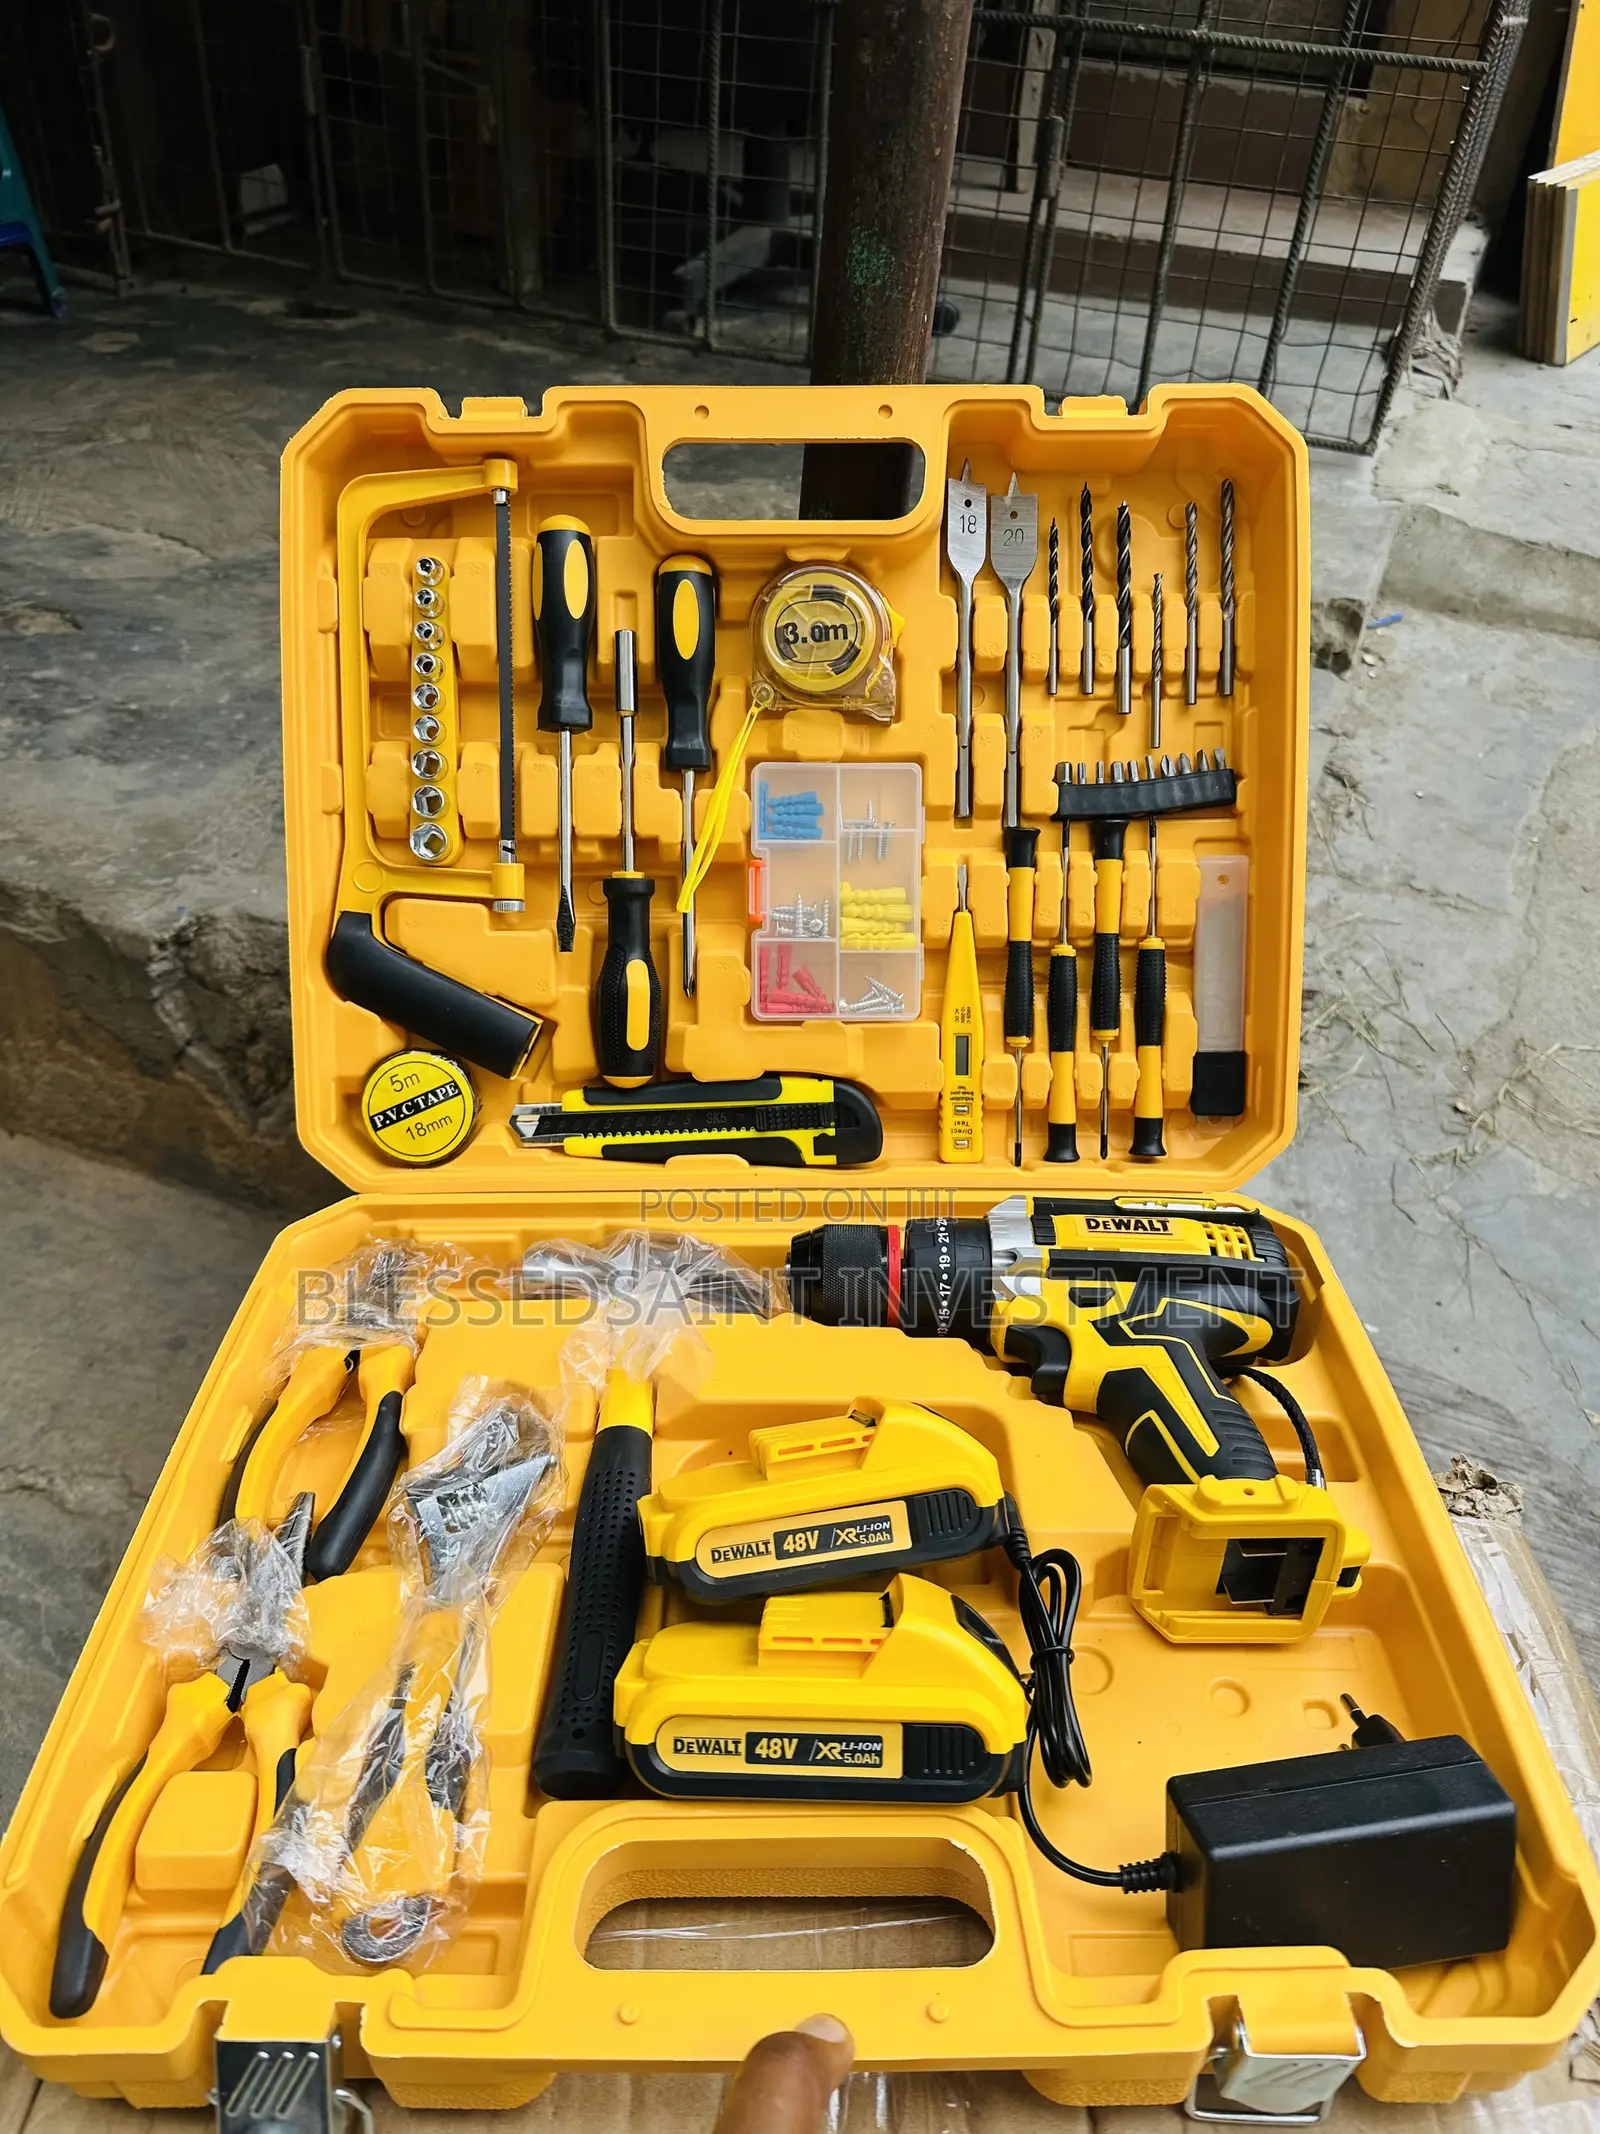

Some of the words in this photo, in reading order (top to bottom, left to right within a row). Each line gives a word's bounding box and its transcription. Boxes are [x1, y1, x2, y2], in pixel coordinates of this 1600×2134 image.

[960, 514, 977, 534] 18
[1003, 528, 1024, 547] 20
[783, 622, 848, 644] 3.0m
[390, 1073, 421, 1093] 5m
[373, 1102, 415, 1128] P.V.C
[414, 1082, 459, 1109] TAPE
[706, 1112, 727, 1125] SK5
[405, 1115, 453, 1140] 18mm
[1085, 1217, 1171, 1233] DEWALT
[938, 1232, 950, 1244] 21
[939, 1254, 951, 1270] 19
[940, 1282, 951, 1297] 17
[938, 1308, 950, 1321] 15
[856, 1521, 891, 1534] LI-ION
[859, 1532, 891, 1545] 5.0Ah
[711, 1540, 772, 1564] DEWALT
[783, 1530, 820, 1554] 48V
[673, 1738, 742, 1755] DEWALT
[755, 1737, 799, 1760] 48V
[841, 1742, 883, 1751] LI-ION
[843, 1752, 880, 1765] 5.0Ah
